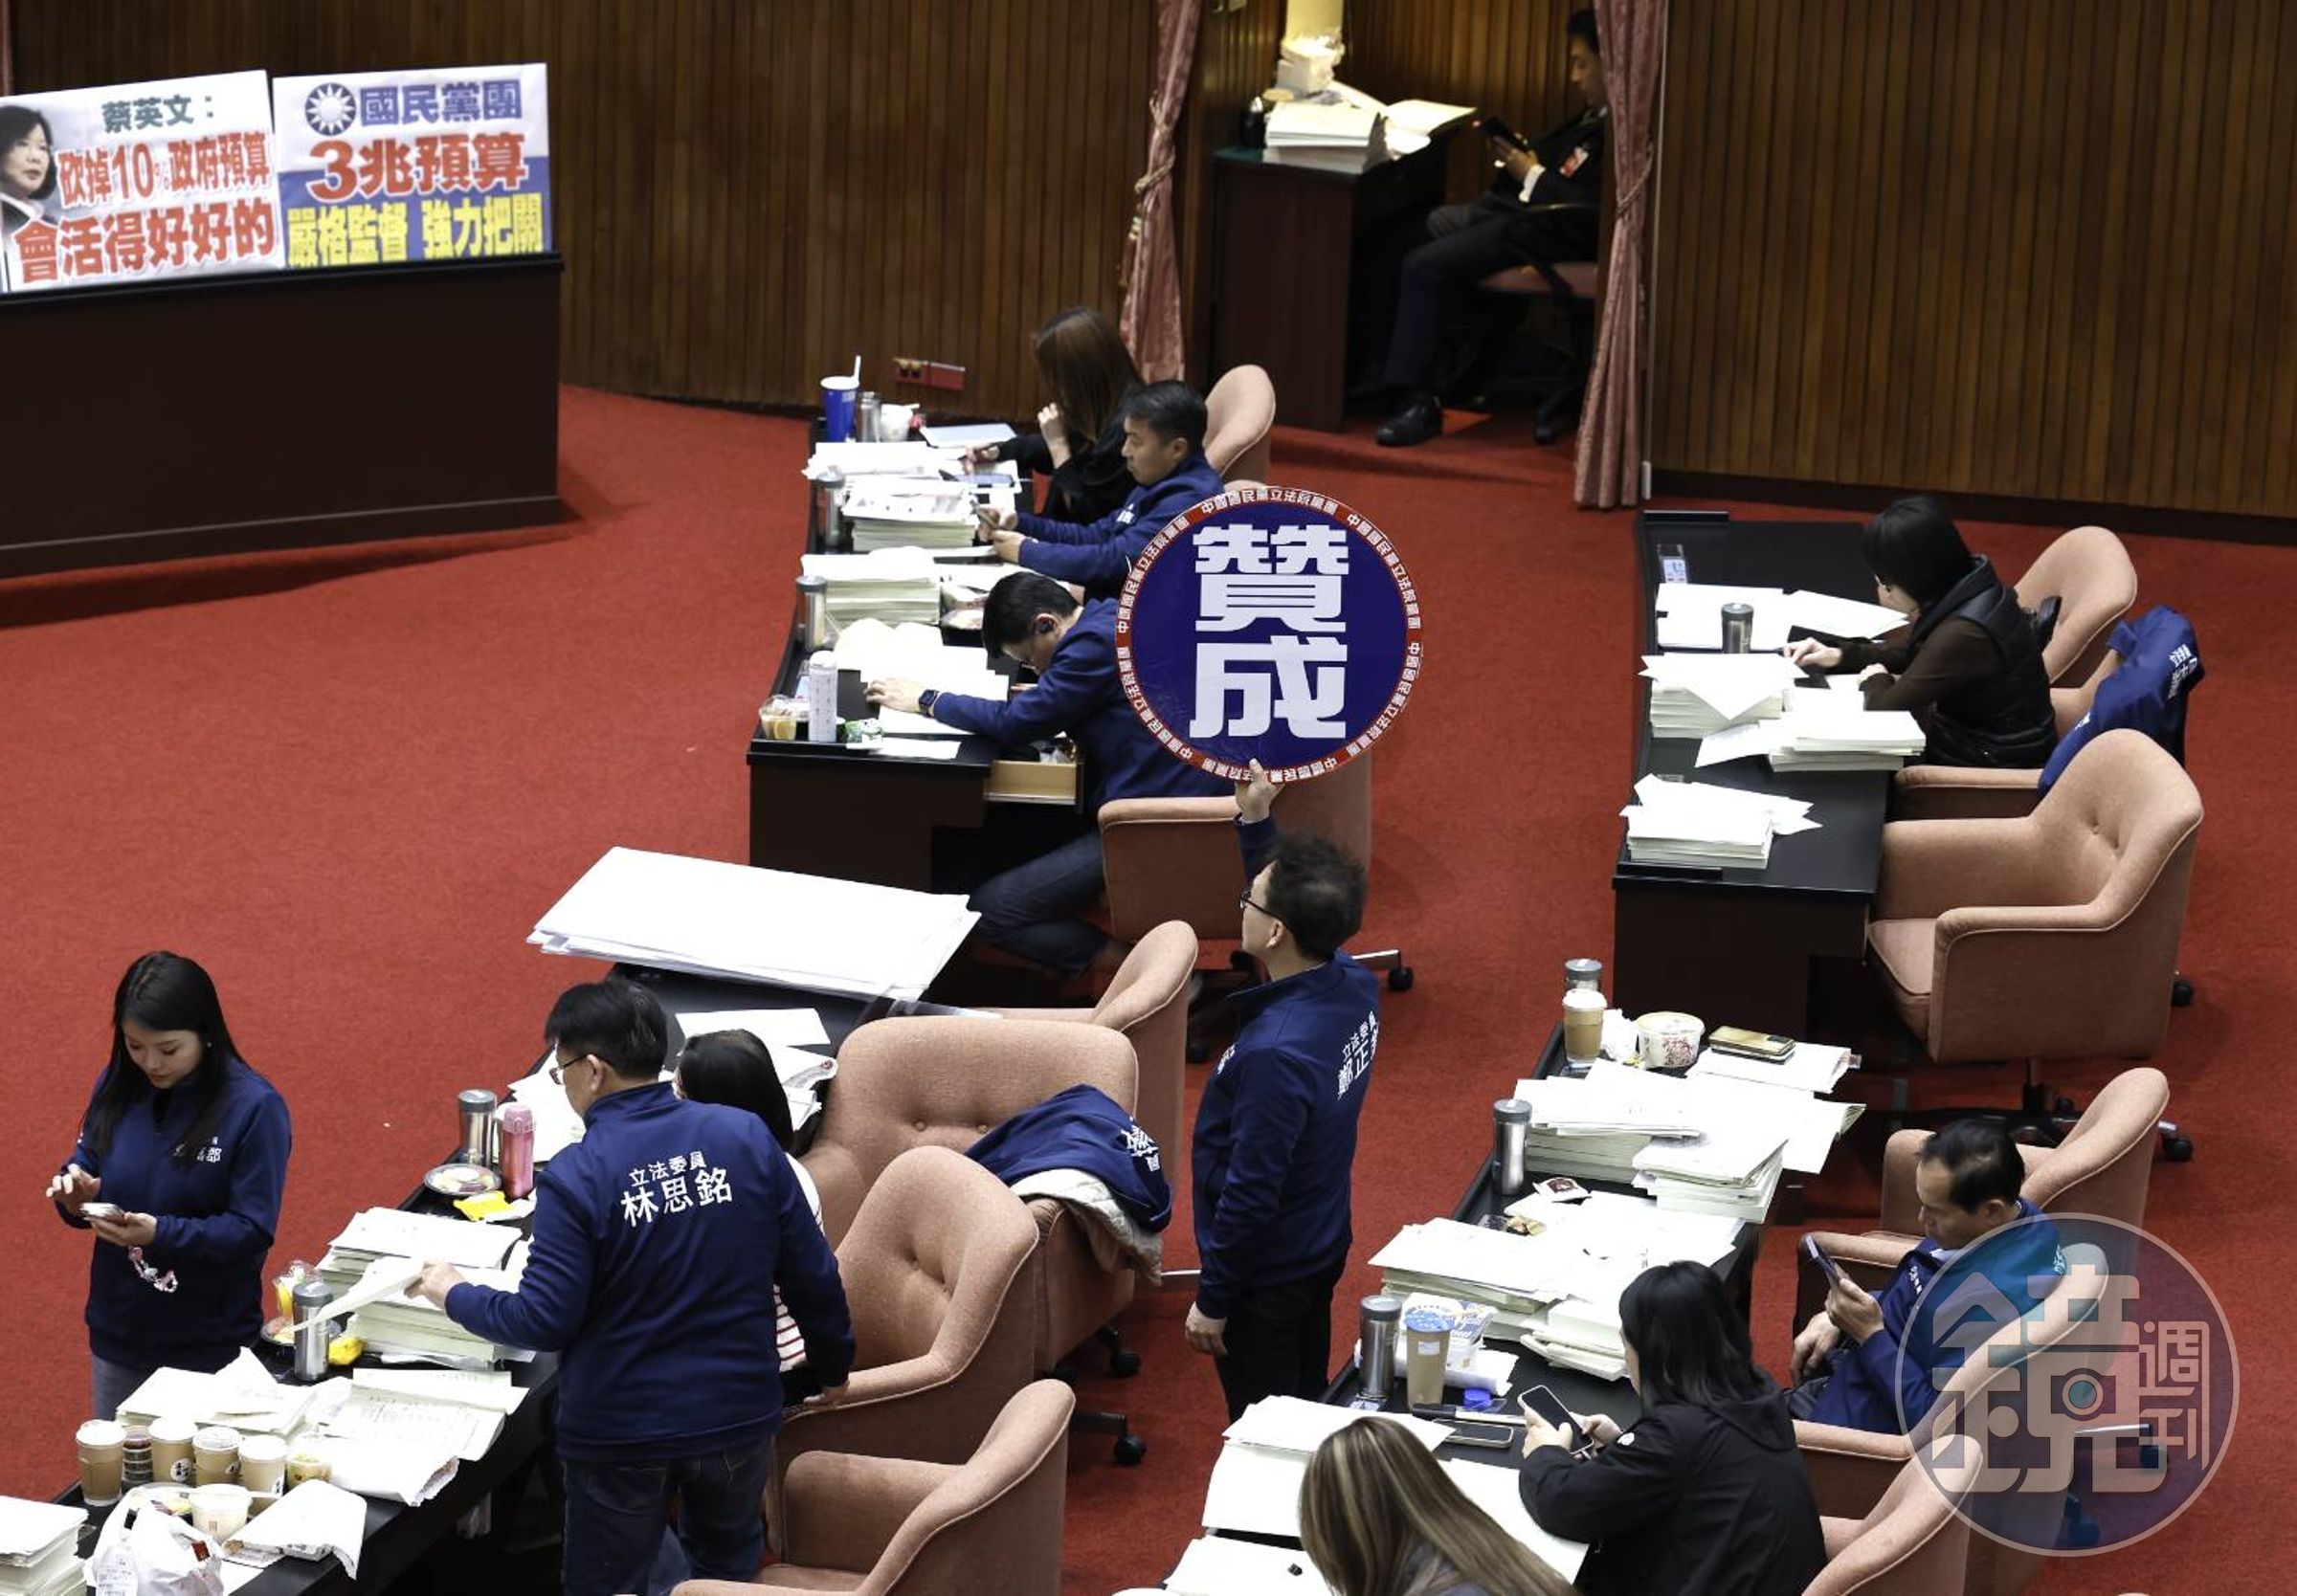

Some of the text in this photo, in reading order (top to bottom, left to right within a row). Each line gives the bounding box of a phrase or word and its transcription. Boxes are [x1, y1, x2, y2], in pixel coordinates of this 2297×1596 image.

[359, 79, 523, 126] 國民黨團
[309, 132, 526, 201] 3兆預算
[14, 196, 276, 284] 會活得好好的
[287, 192, 544, 268] 嚴格監督 強力把關
[1190, 523, 1349, 739] 贊成
[1201, 758, 1338, 784] 中國國民黨法院黨團
[620, 1166, 733, 1228] 林思銘
[628, 1150, 707, 1187] 立法委員
